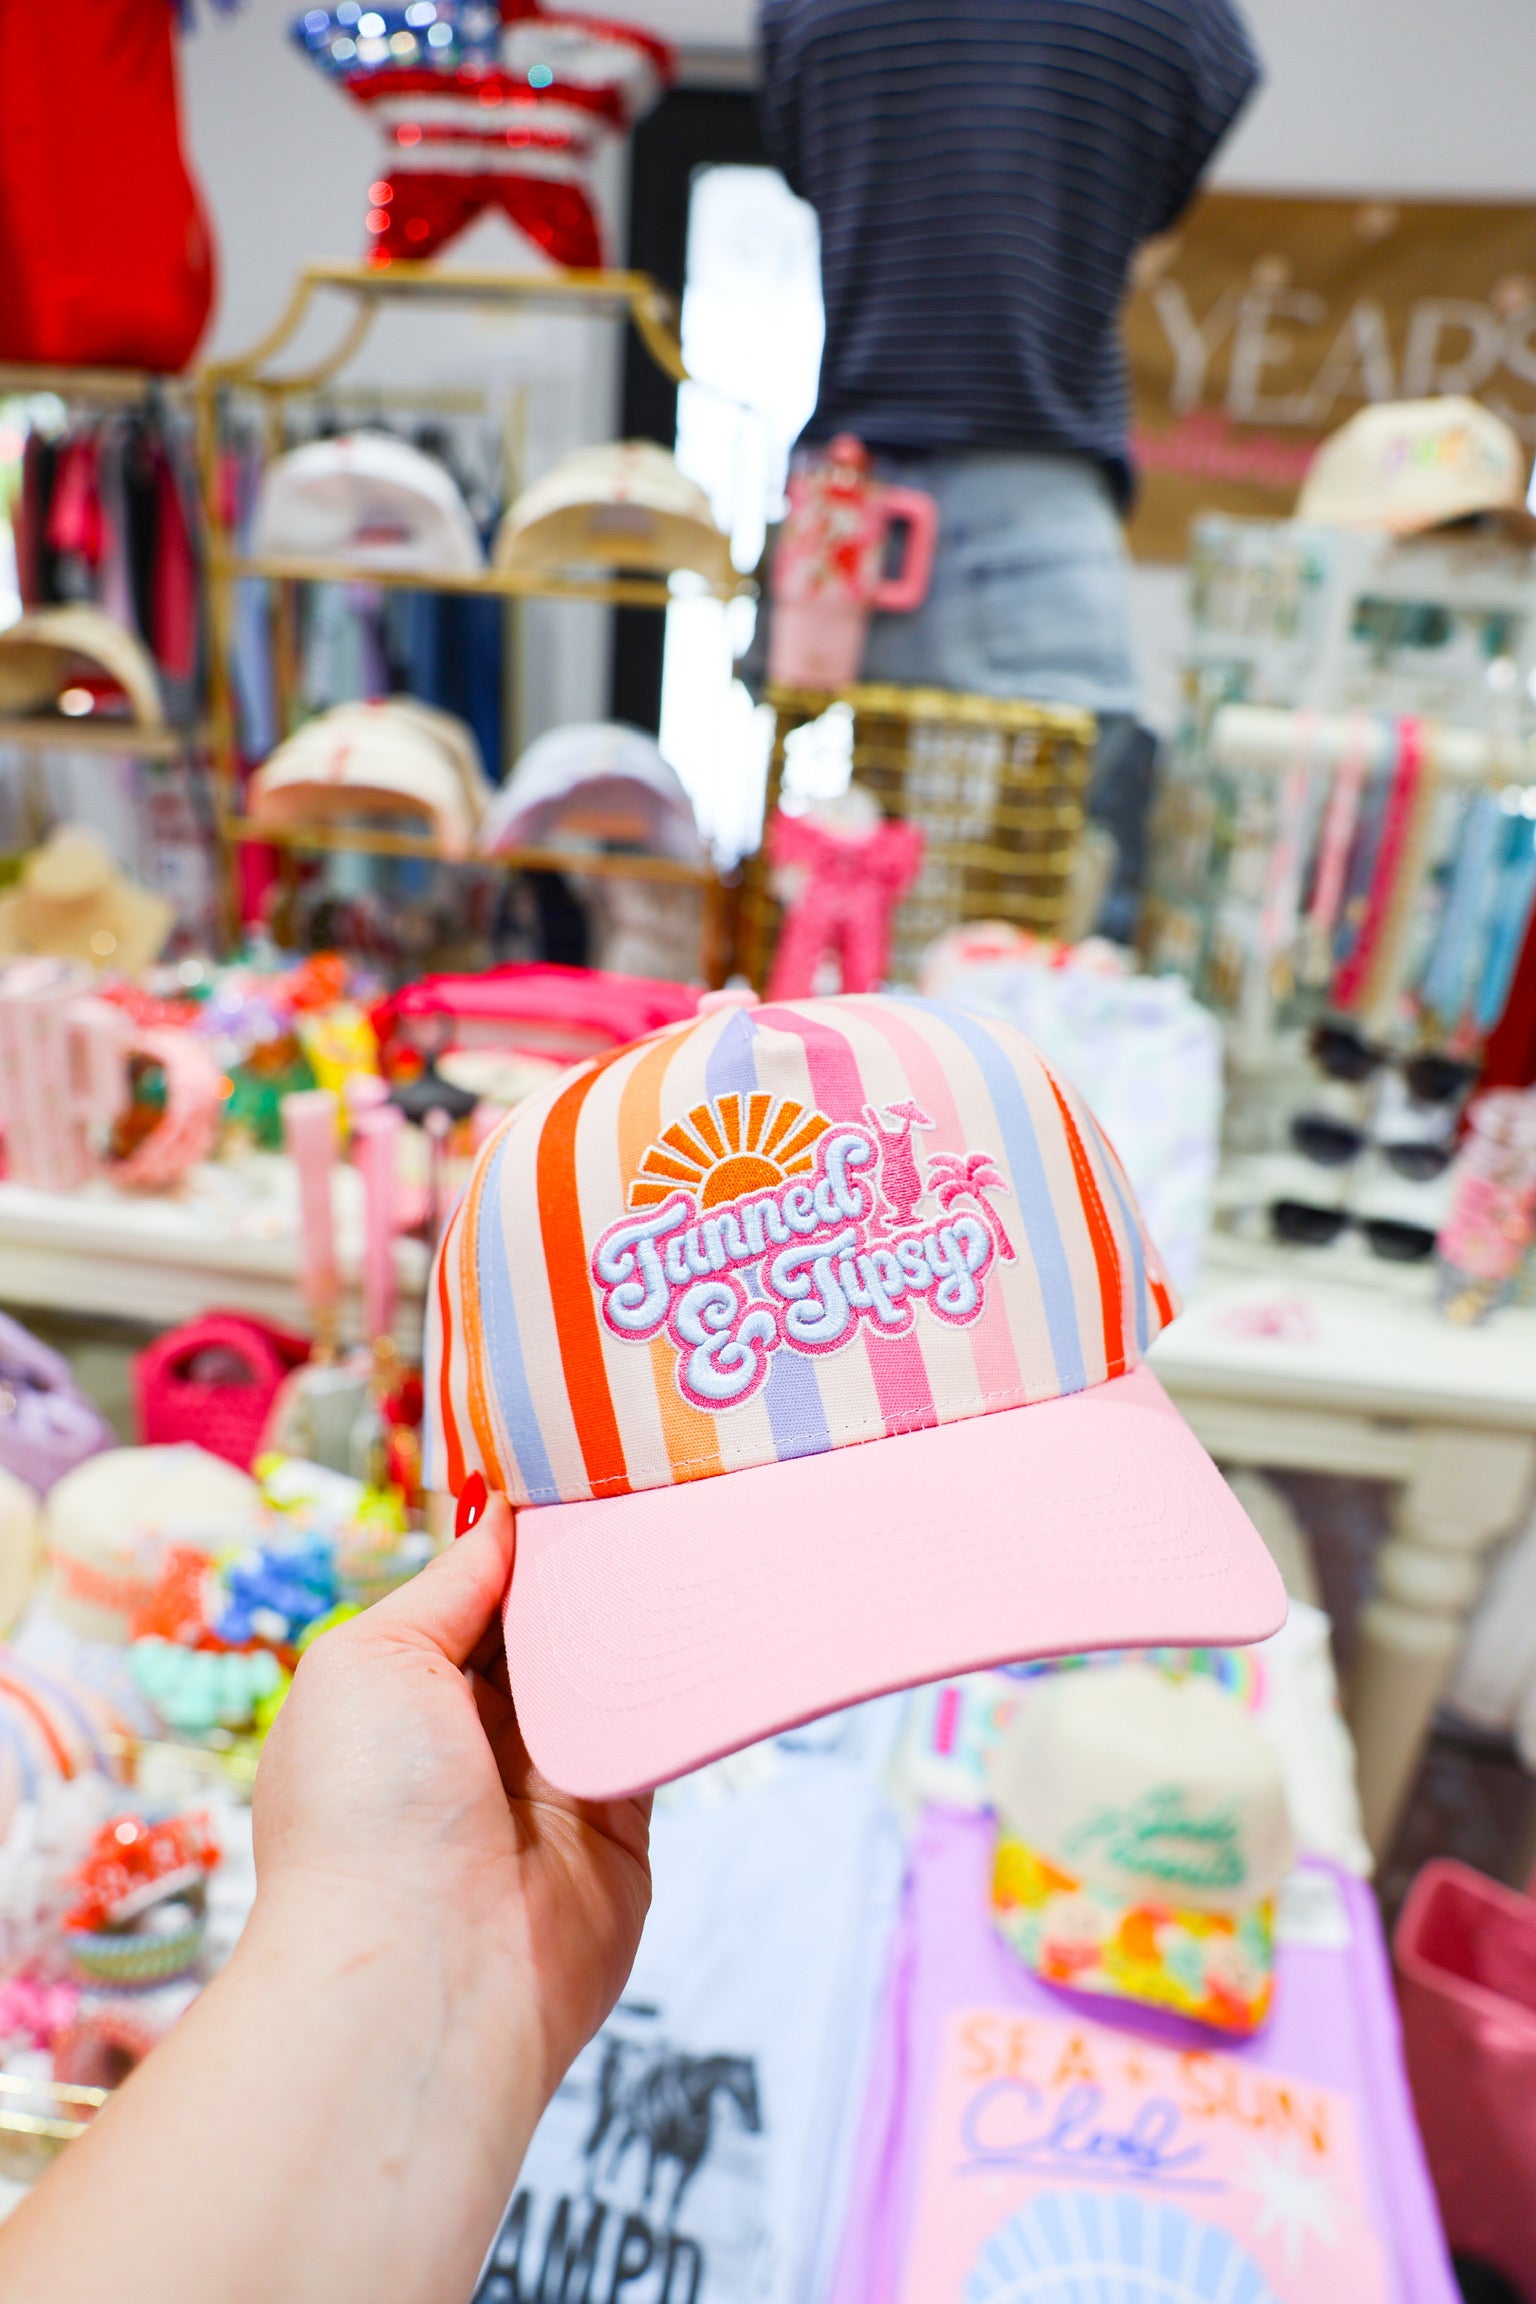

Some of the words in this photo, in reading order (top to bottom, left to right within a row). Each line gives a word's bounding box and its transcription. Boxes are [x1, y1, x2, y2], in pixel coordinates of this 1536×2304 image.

[593, 1126, 878, 1336] Tanned
[668, 1277, 782, 1407] &
[764, 1212, 992, 1350] Tipsy
[959, 2076, 1206, 2168] Club
[961, 2014, 1093, 2086] SEA
[1178, 2050, 1330, 2154] SUN
